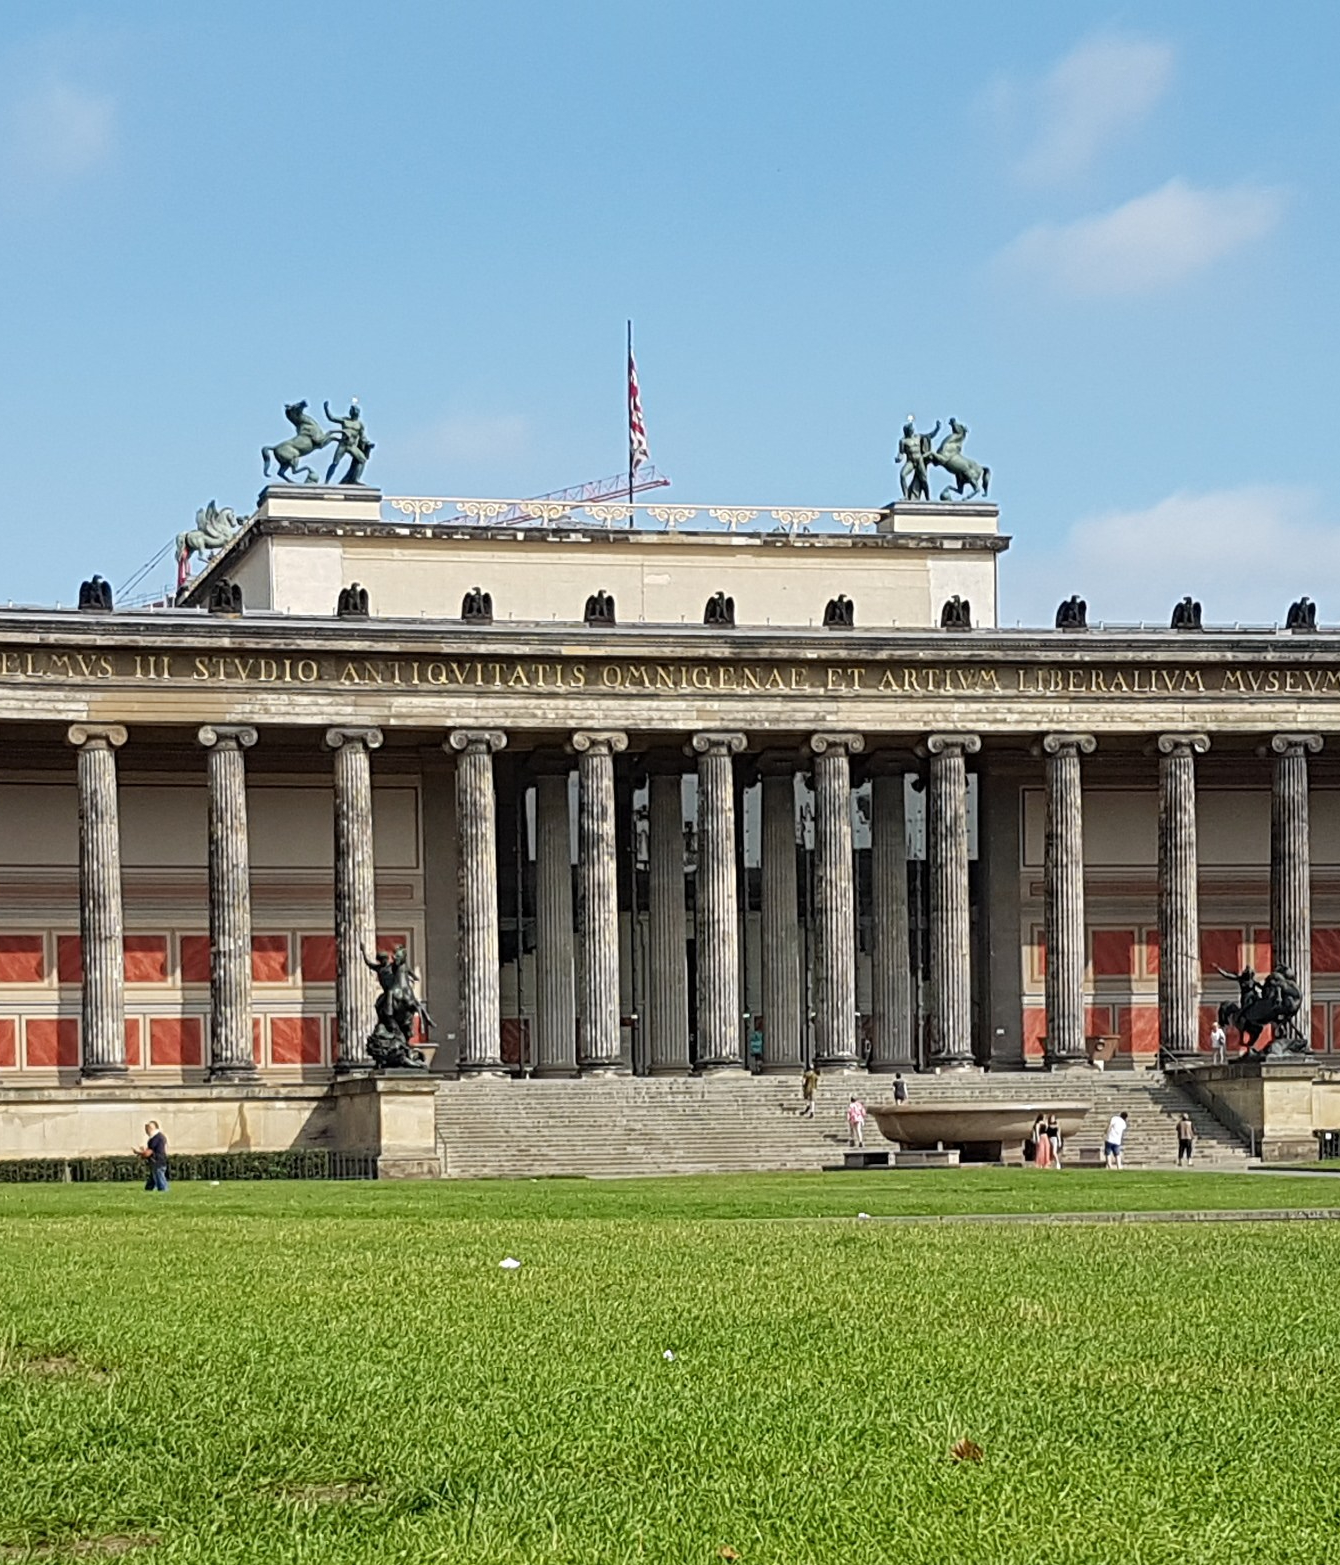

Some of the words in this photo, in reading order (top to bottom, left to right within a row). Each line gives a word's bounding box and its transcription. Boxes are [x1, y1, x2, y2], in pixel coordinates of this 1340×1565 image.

[134, 655, 172, 680] III
[193, 657, 319, 682] STVDIO
[340, 661, 586, 687] ANTIQVITATIS
[603, 664, 809, 690] OMNIGENAE
[826, 667, 865, 690] ET
[877, 667, 1003, 693] ARTIVM
[1017, 669, 1206, 693] LIBERALIVM
